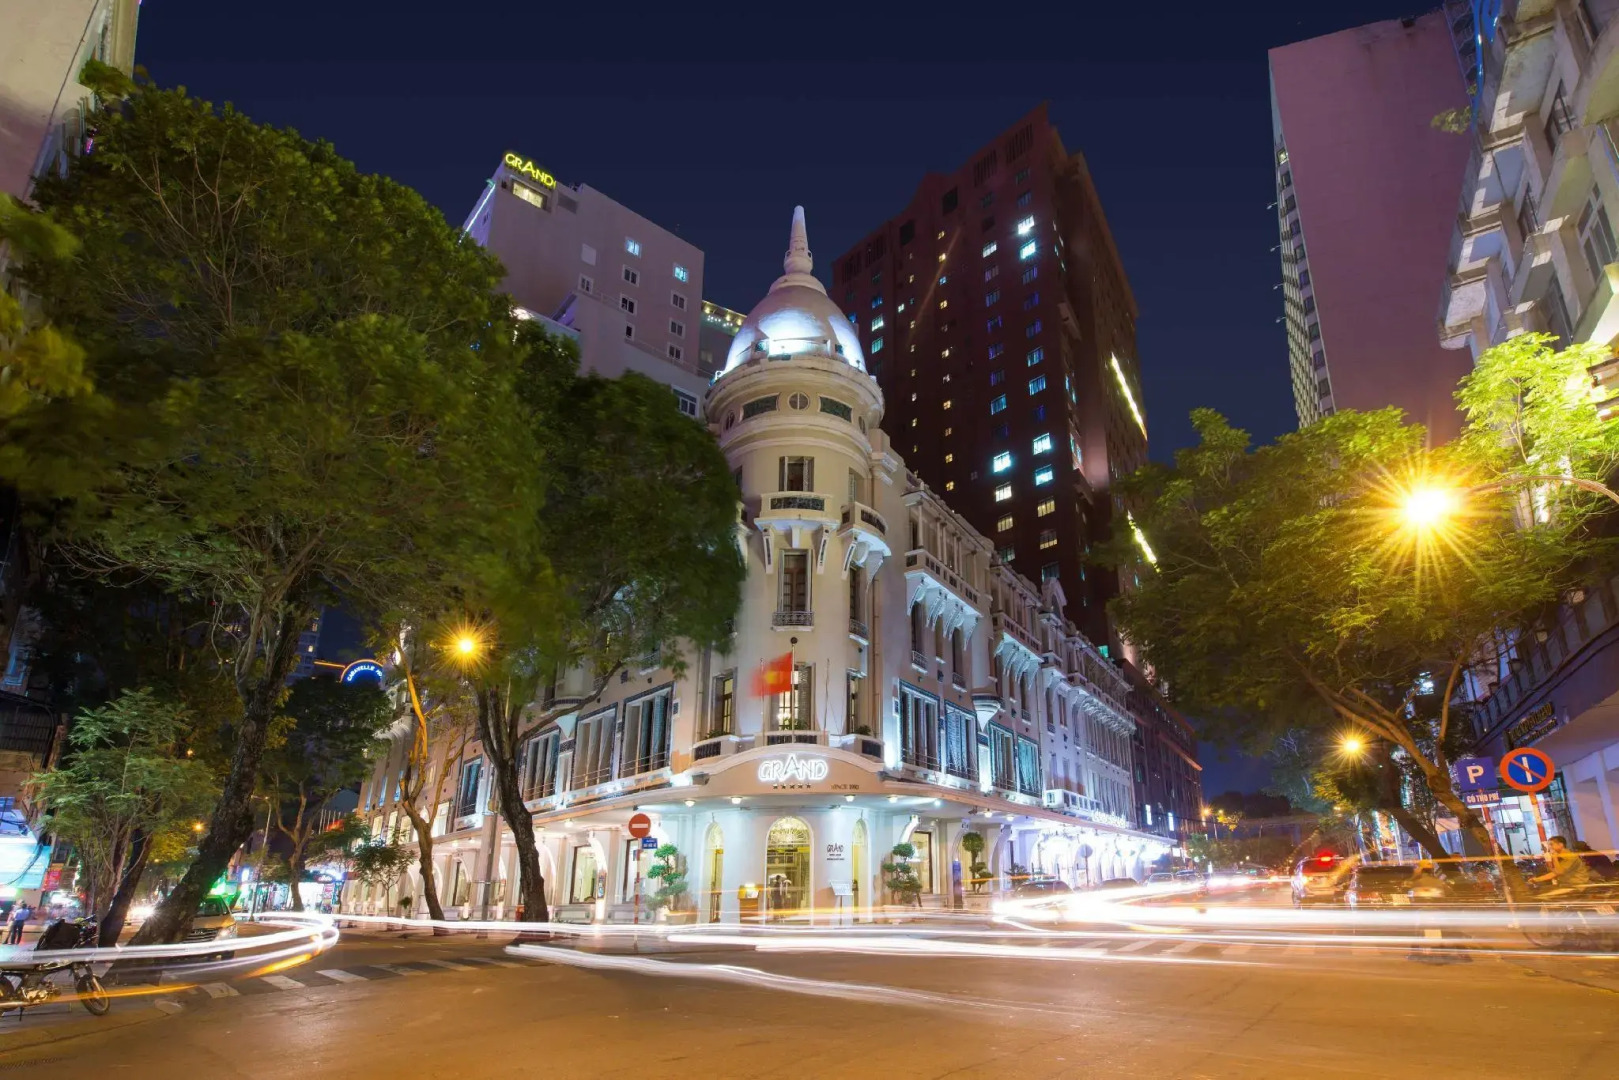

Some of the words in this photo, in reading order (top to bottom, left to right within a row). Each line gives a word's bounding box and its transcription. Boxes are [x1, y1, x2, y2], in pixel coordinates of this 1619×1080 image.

[505, 153, 554, 187] GRAND
[347, 665, 375, 681] CARAVELLE
[759, 754, 828, 782] GRAND
[1466, 765, 1484, 784] P
[826, 843, 845, 853] GRAND
